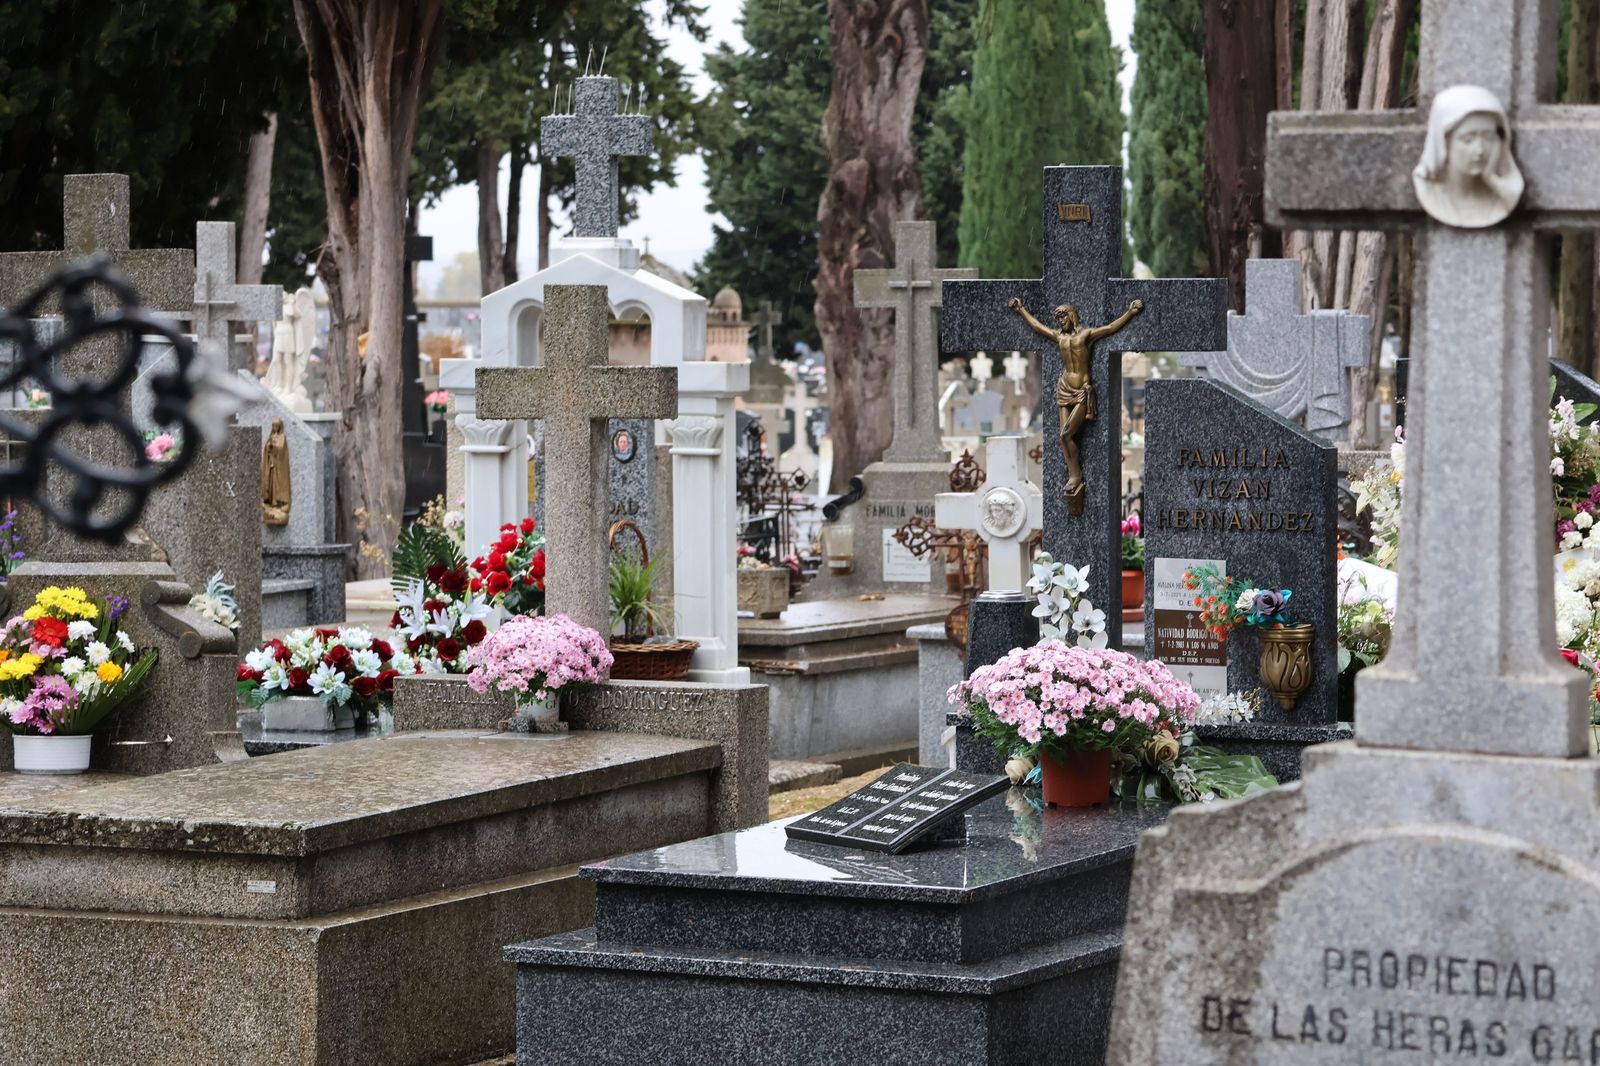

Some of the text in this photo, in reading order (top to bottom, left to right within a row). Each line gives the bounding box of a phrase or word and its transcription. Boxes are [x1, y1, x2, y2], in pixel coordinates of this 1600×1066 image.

[1177, 448, 1290, 469] FAMILIA
[1190, 479, 1272, 499] VIZAN
[866, 505, 906, 517] FAMILIA
[1156, 508, 1314, 532] HERNANDEZ
[601, 690, 704, 712] DOMINGUEZ
[1323, 947, 1556, 1001] PROPIEDAD
[1200, 997, 1252, 1035] DE
[1270, 1002, 1348, 1045] LAS
[1372, 1009, 1508, 1058] HERAS
